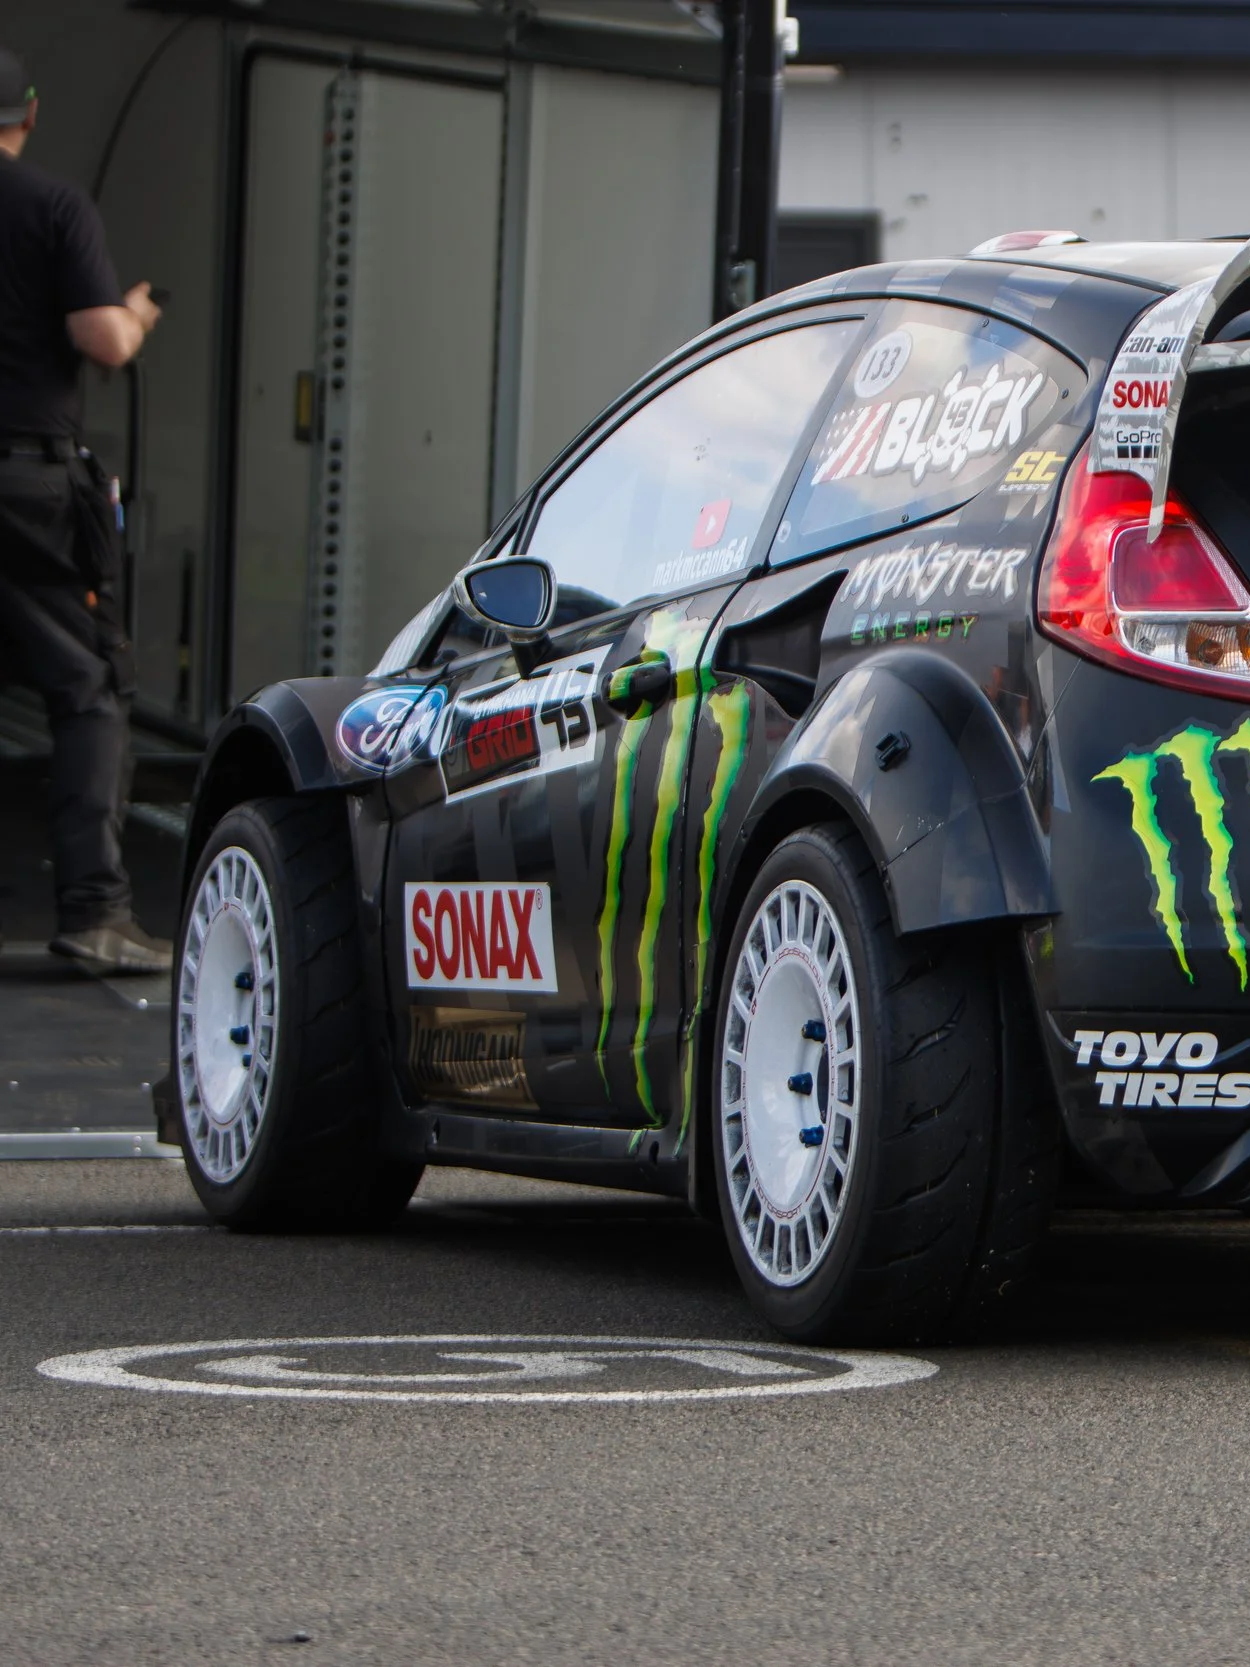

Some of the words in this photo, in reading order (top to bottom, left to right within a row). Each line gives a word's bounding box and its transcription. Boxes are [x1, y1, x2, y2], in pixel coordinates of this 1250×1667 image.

[863, 346, 902, 381] 133
[1113, 380, 1172, 409] SONA
[653, 536, 748, 587] markmccann64
[852, 614, 976, 641] ENERGY
[467, 706, 534, 770] GRID
[1074, 1030, 1218, 1067] TOYO
